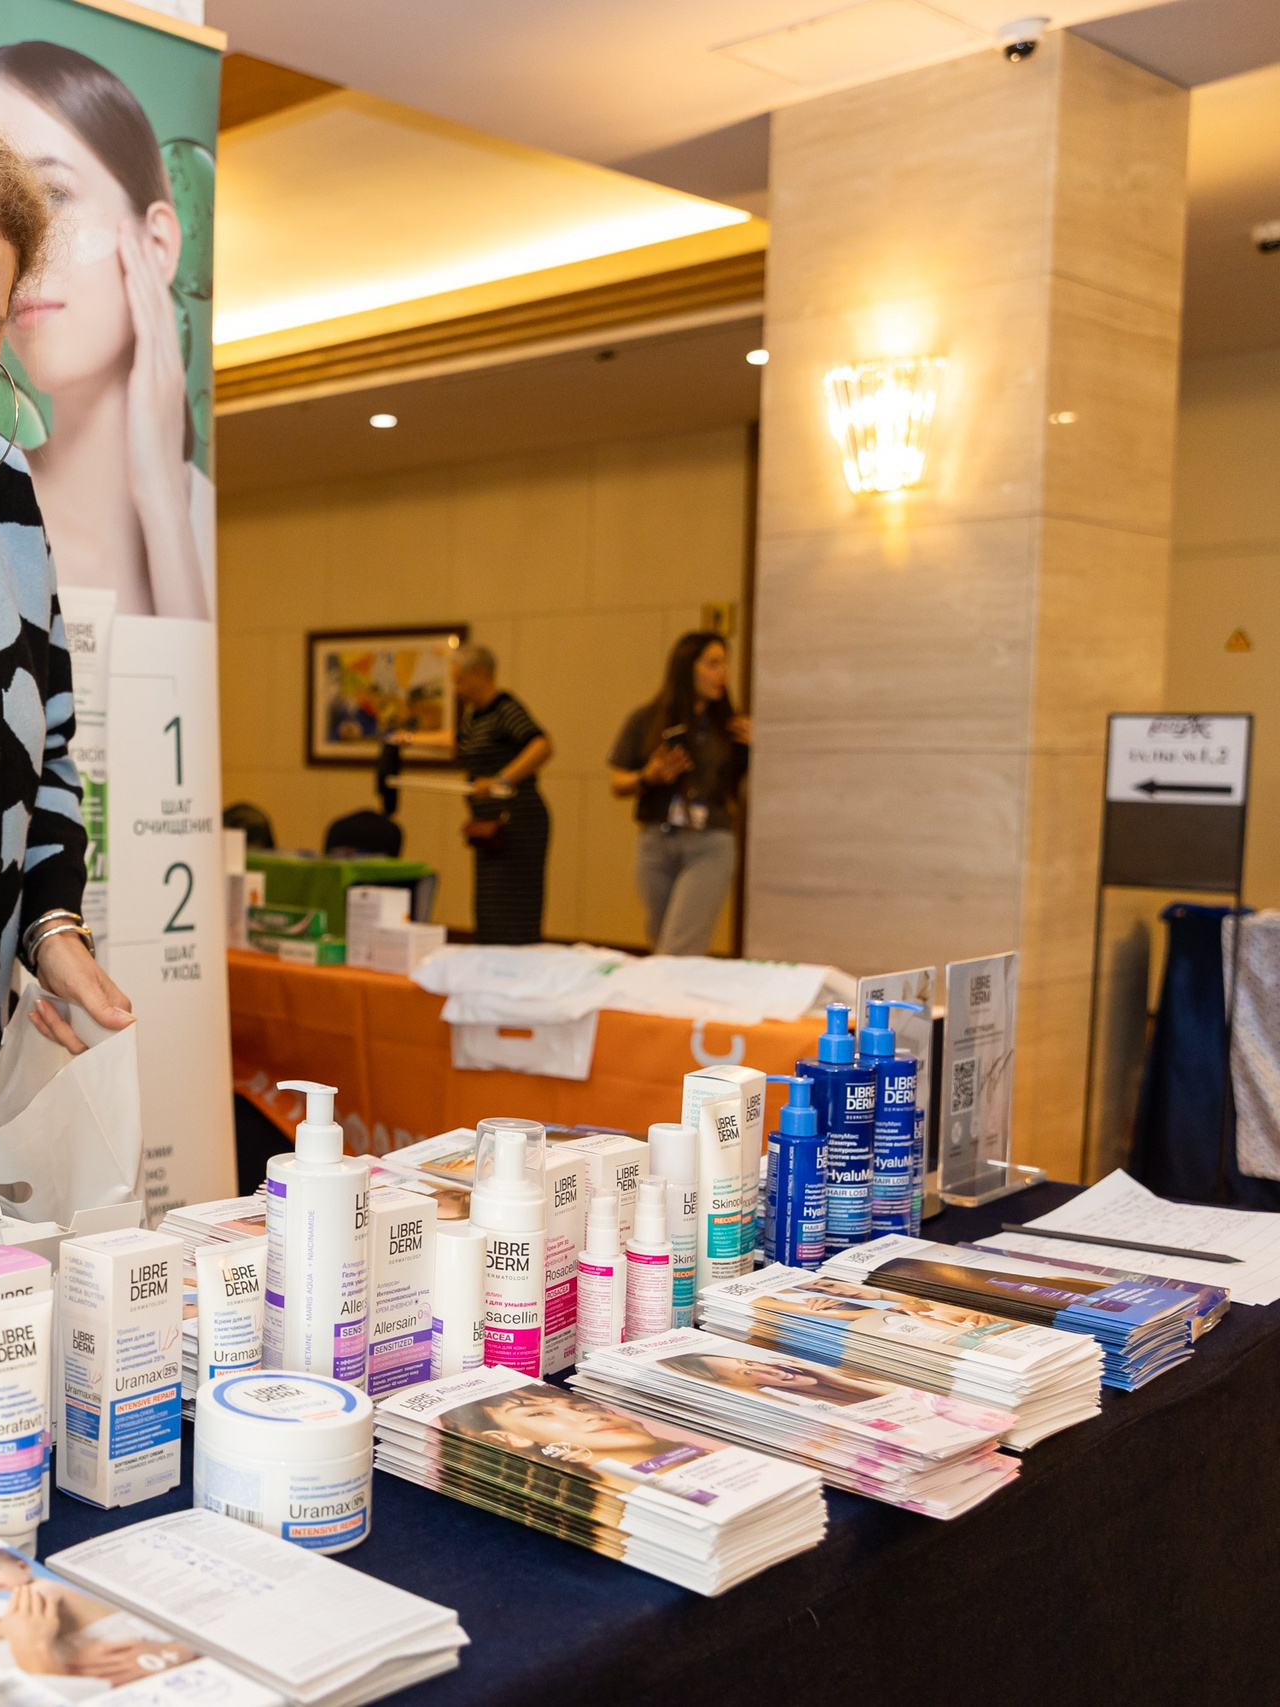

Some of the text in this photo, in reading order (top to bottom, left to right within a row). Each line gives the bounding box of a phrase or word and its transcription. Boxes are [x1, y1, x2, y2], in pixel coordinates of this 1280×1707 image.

[163, 715, 183, 786] 1
[160, 800, 195, 815] ШАГ
[132, 817, 213, 836] ОЧИЩЕНИЕ
[162, 861, 196, 935] 2
[163, 945, 197, 962] ШАГ
[161, 963, 201, 982] УХОД
[970, 975, 991, 990] LIBRE
[970, 990, 991, 1006] DERM
[718, 1127, 740, 1142] DERM
[617, 1164, 640, 1181] LIBRE
[892, 1177, 909, 1185] LOSS
[554, 1174, 577, 1194] LIBRE
[554, 1188, 577, 1208] DERM
[827, 1189, 848, 1197] HAIR
[307, 1210, 316, 1261] NIACINAMIDE
[390, 1220, 423, 1240] LIBRE
[389, 1235, 423, 1255] DERM
[388, 1253, 422, 1265] DERMATOLOGY
[131, 1261, 168, 1285] LIBRE
[222, 1264, 257, 1283] LIBRE
[69, 1276, 100, 1291] CERAMIDES
[130, 1278, 168, 1302] DERM
[225, 1279, 260, 1298] DERM
[376, 1285, 411, 1298] Интенсивный
[377, 1280, 400, 1290] Аллерсан
[376, 1289, 430, 1307] успокаивающий уход
[547, 1286, 569, 1300] ROSACEA
[130, 1299, 168, 1312] DERMATOLOGY
[375, 1300, 413, 1314] КРЕМ ДНЕВНОЙ
[488, 1298, 537, 1308] для умывания
[214, 1317, 232, 1326] Крем
[373, 1315, 417, 1336] Allersain
[486, 1310, 538, 1325] sacellin
[72, 1328, 95, 1345] LIBRE
[116, 1337, 133, 1345] Крем
[72, 1339, 95, 1355] DERM
[116, 1341, 156, 1355] смягчающий
[304, 1332, 312, 1366] BETAINE
[375, 1338, 413, 1355] SENSITIZED
[214, 1348, 259, 1363] Uramax
[115, 1364, 178, 1393] Uramax 25%
[436, 1378, 487, 1396] Allersain
[65, 1382, 91, 1399] Uramax
[243, 1384, 290, 1398] LIBRE
[254, 1390, 306, 1403] DERM
[116, 1389, 175, 1413] INTENSIVE REPAIR
[289, 1501, 351, 1520] Uramax
[291, 1515, 362, 1536] INTENSIVE REPAIR
